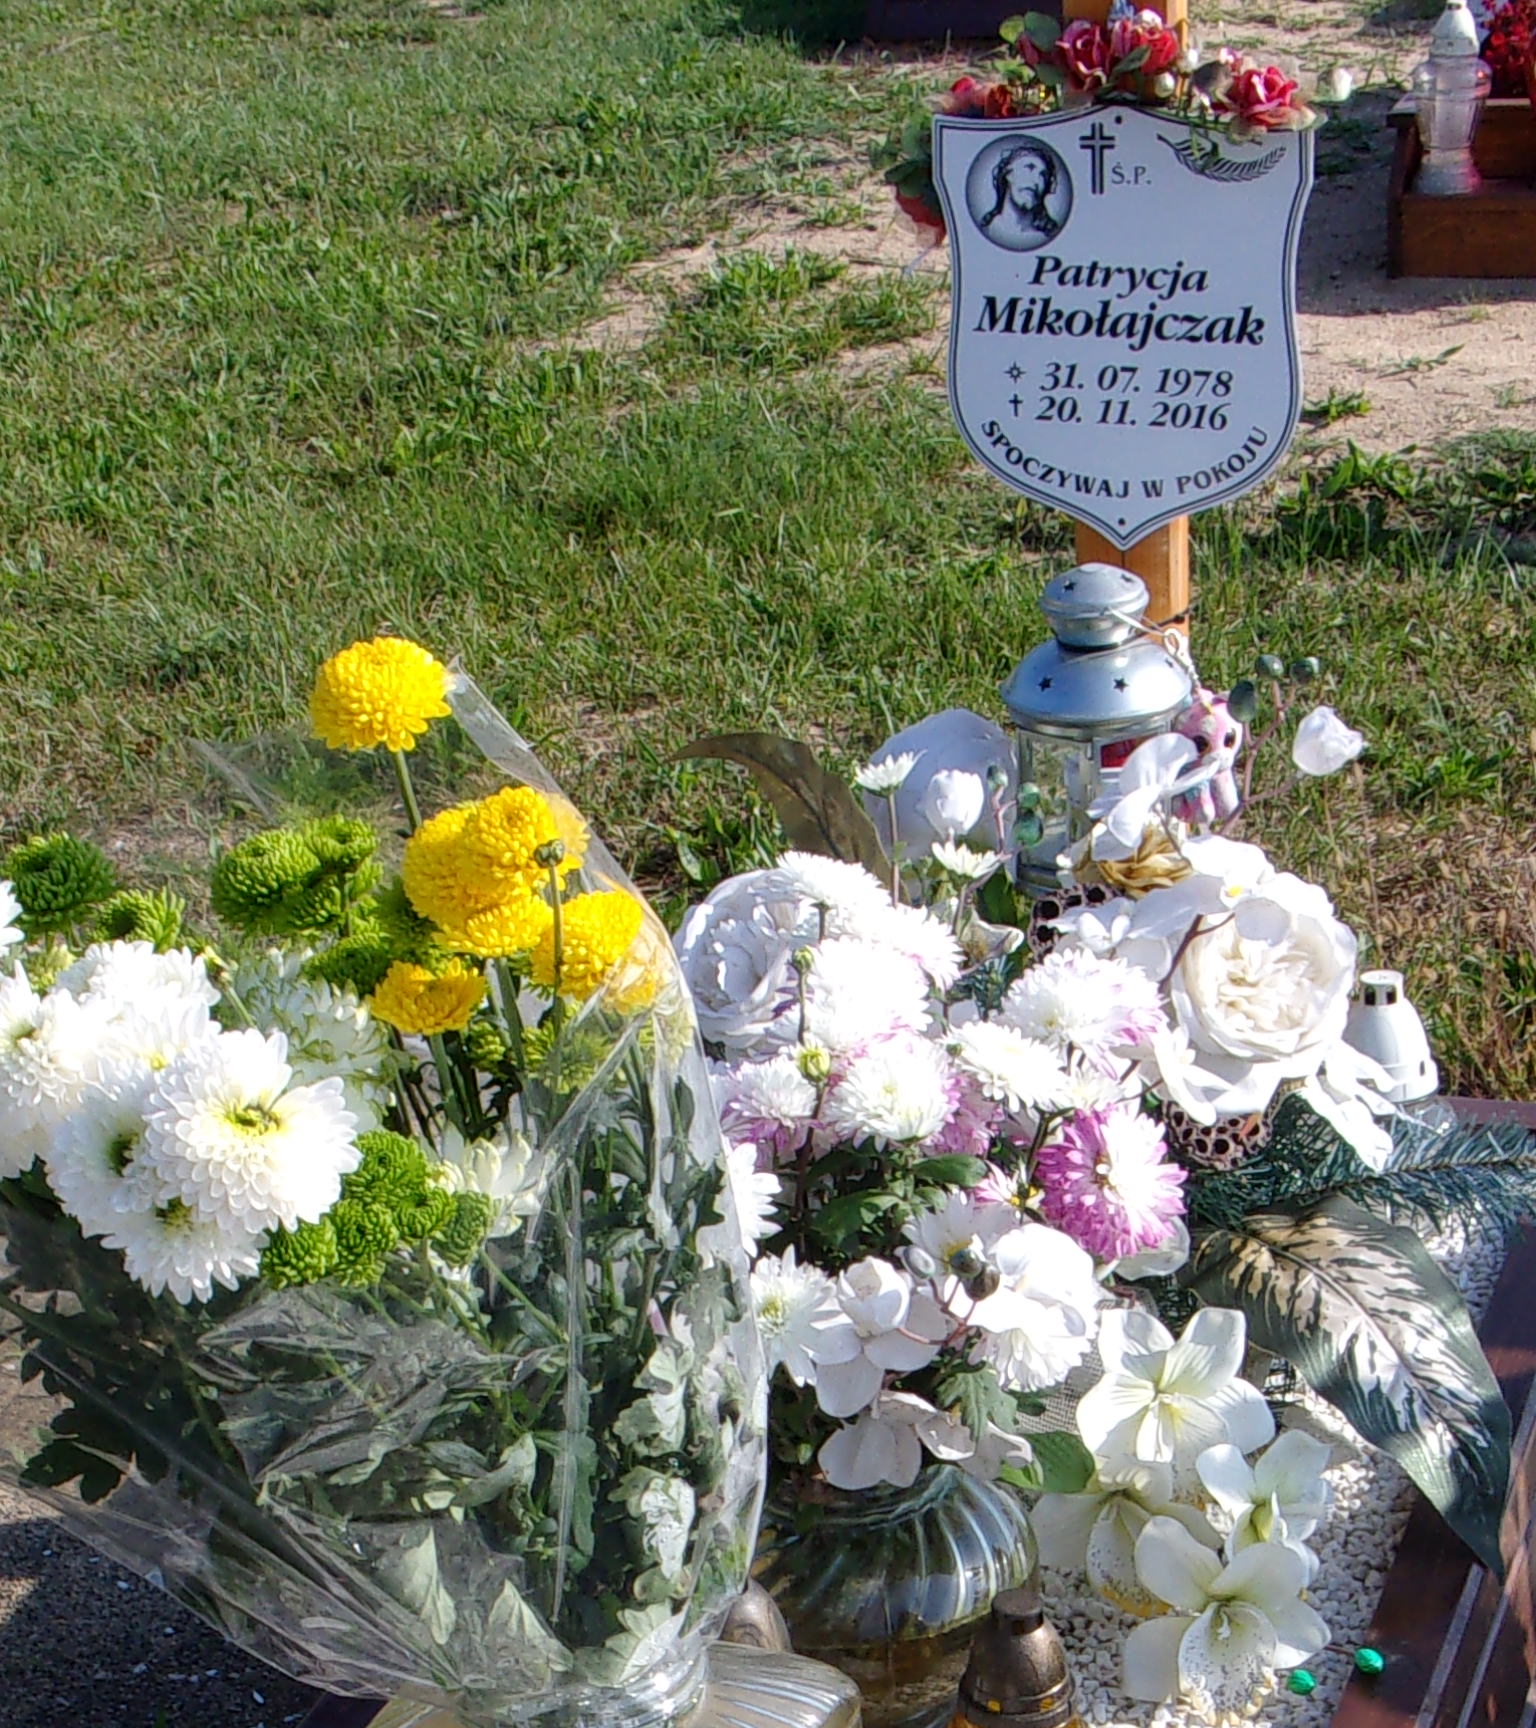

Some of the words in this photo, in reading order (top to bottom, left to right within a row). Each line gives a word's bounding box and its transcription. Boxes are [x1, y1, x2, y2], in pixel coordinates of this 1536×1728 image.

[1027, 255, 1209, 299] Patrycja
[972, 295, 1265, 352] Mikołajczak
[1039, 362, 1085, 391] 31.
[1097, 365, 1141, 394] 07.
[1155, 367, 1234, 398] 1978
[1034, 397, 1082, 424] 20.
[1098, 399, 1137, 427] 11.
[1148, 403, 1232, 431] 2016
[981, 419, 1130, 499] SPOCZYWAJ
[1141, 479, 1166, 500] W
[1177, 426, 1269, 496] POKOJU
